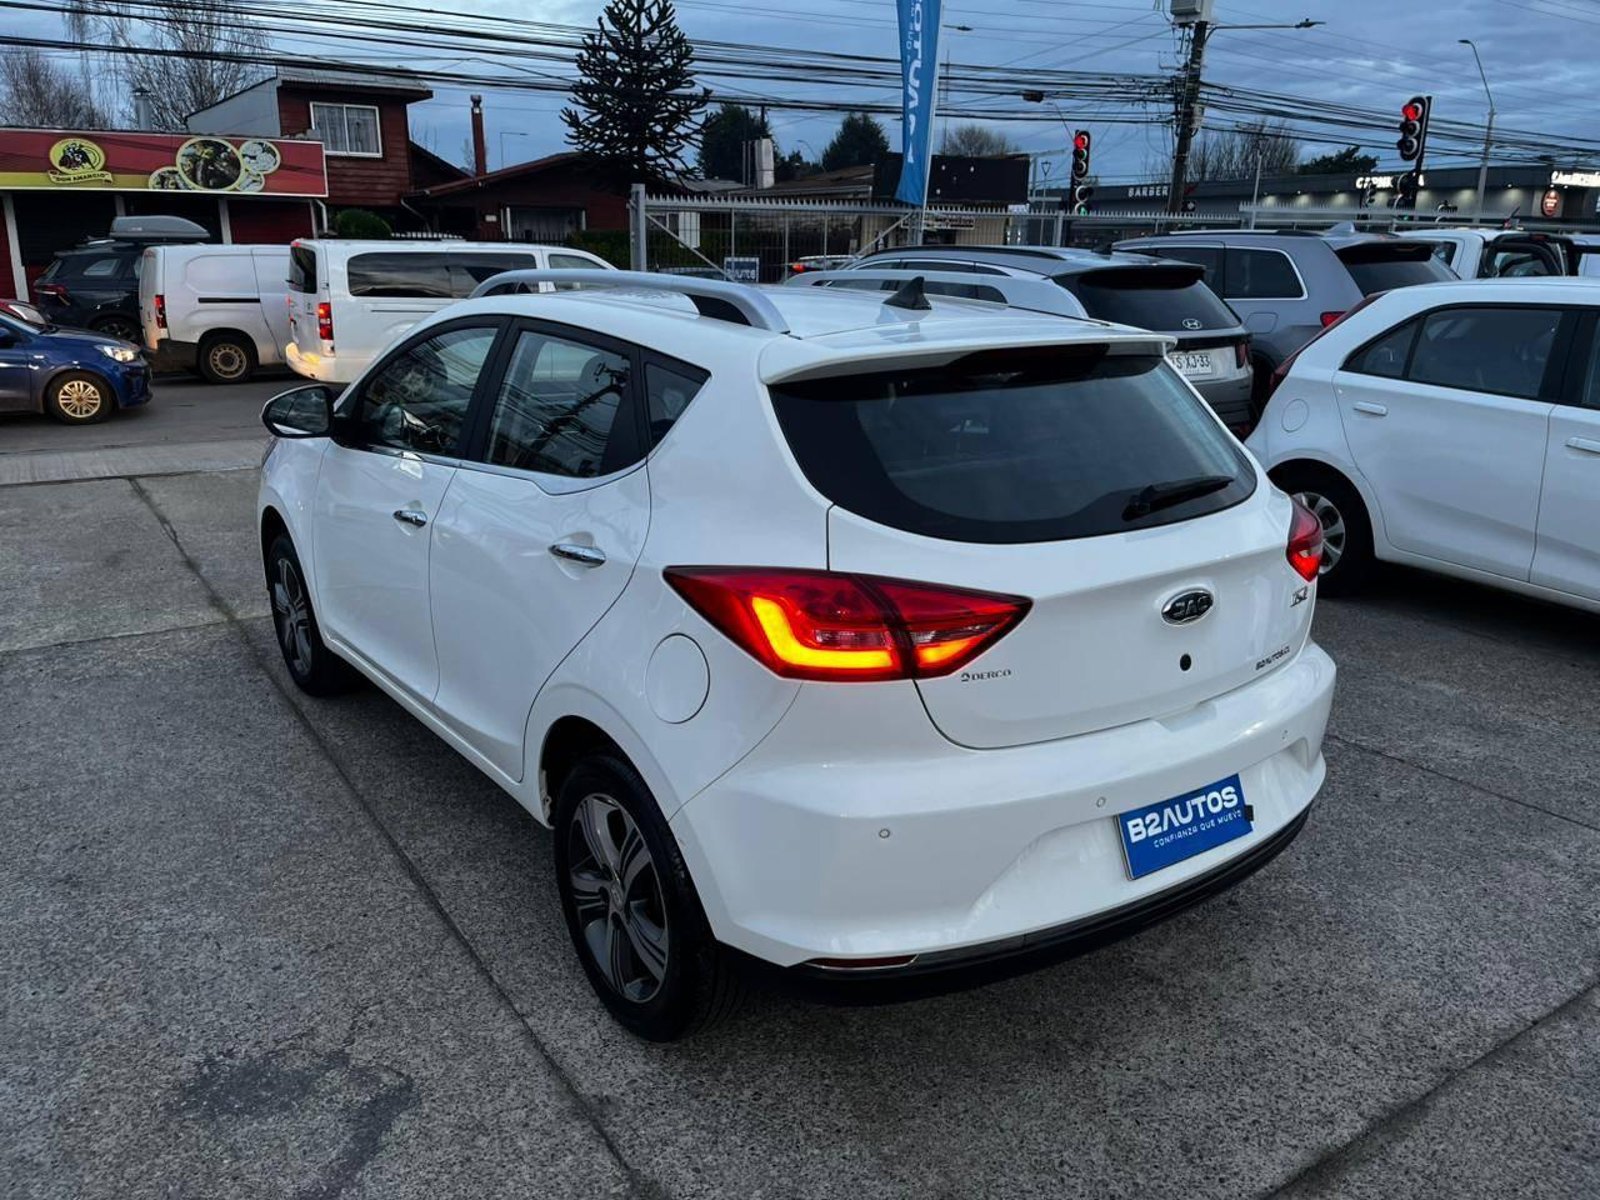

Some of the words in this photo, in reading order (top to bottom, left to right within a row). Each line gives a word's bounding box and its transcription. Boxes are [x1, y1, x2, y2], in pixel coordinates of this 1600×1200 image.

[1128, 186, 1169, 198] BARBER
[1127, 786, 1238, 843] B2AUTOS
[1153, 826, 1199, 848] CONFIANZA
[1200, 818, 1216, 831] QUE
